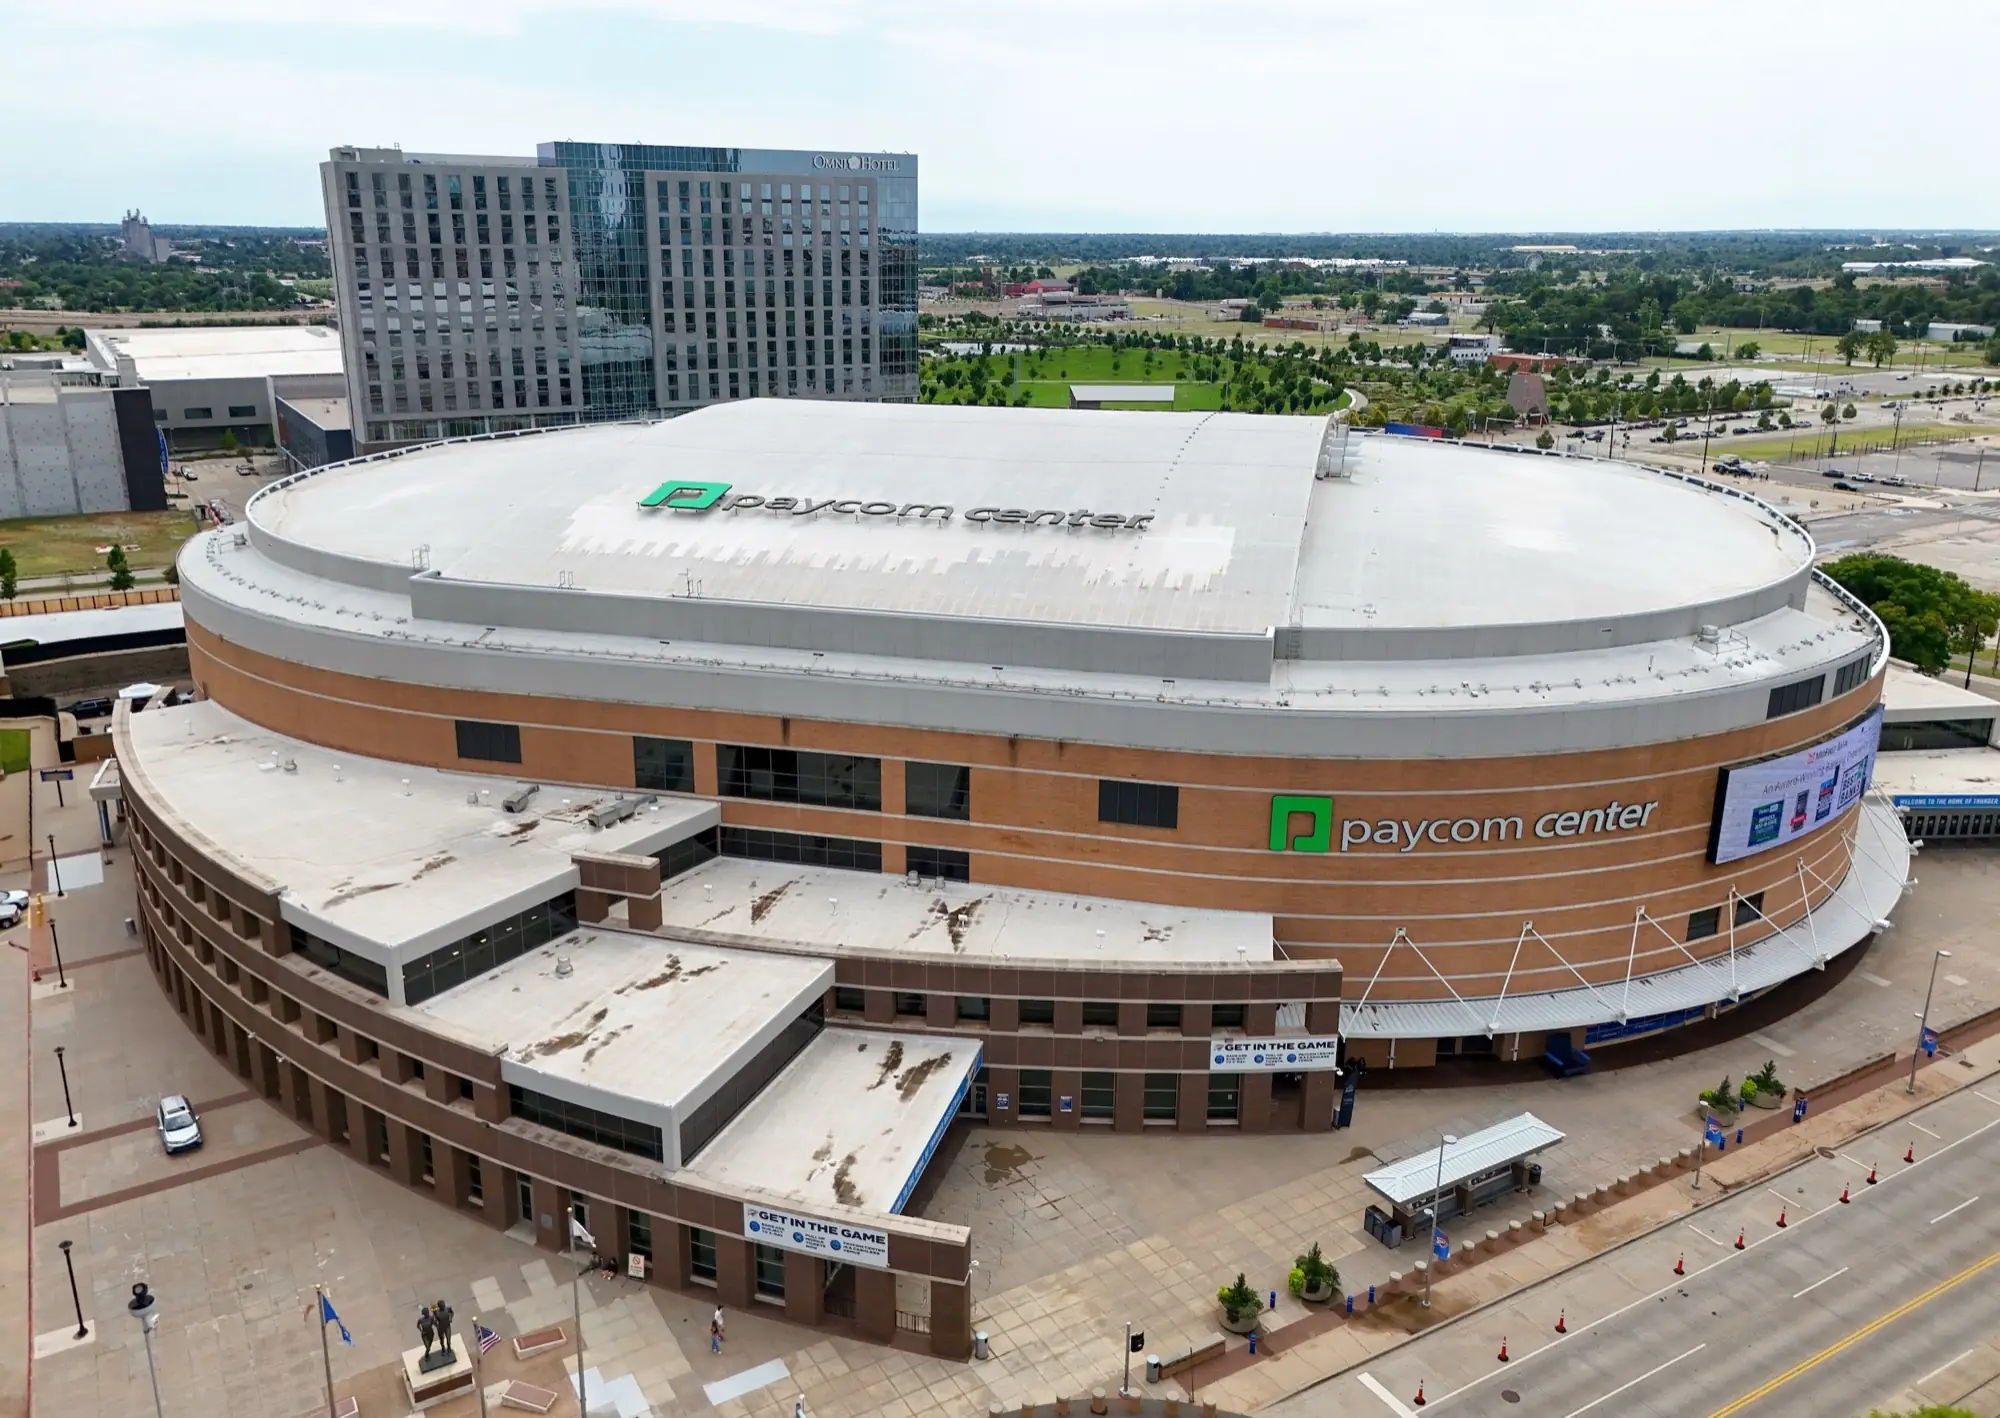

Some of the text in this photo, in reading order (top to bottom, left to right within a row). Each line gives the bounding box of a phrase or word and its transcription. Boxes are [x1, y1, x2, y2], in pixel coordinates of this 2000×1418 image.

[721, 493, 1155, 529] paycom center
[1340, 801, 1659, 853] paycom center
[1224, 1043, 1251, 1052] GET
[1269, 1042, 1295, 1050] THE
[1297, 1041, 1335, 1050] GAME
[758, 1210, 886, 1245] GET IN THE GAME
